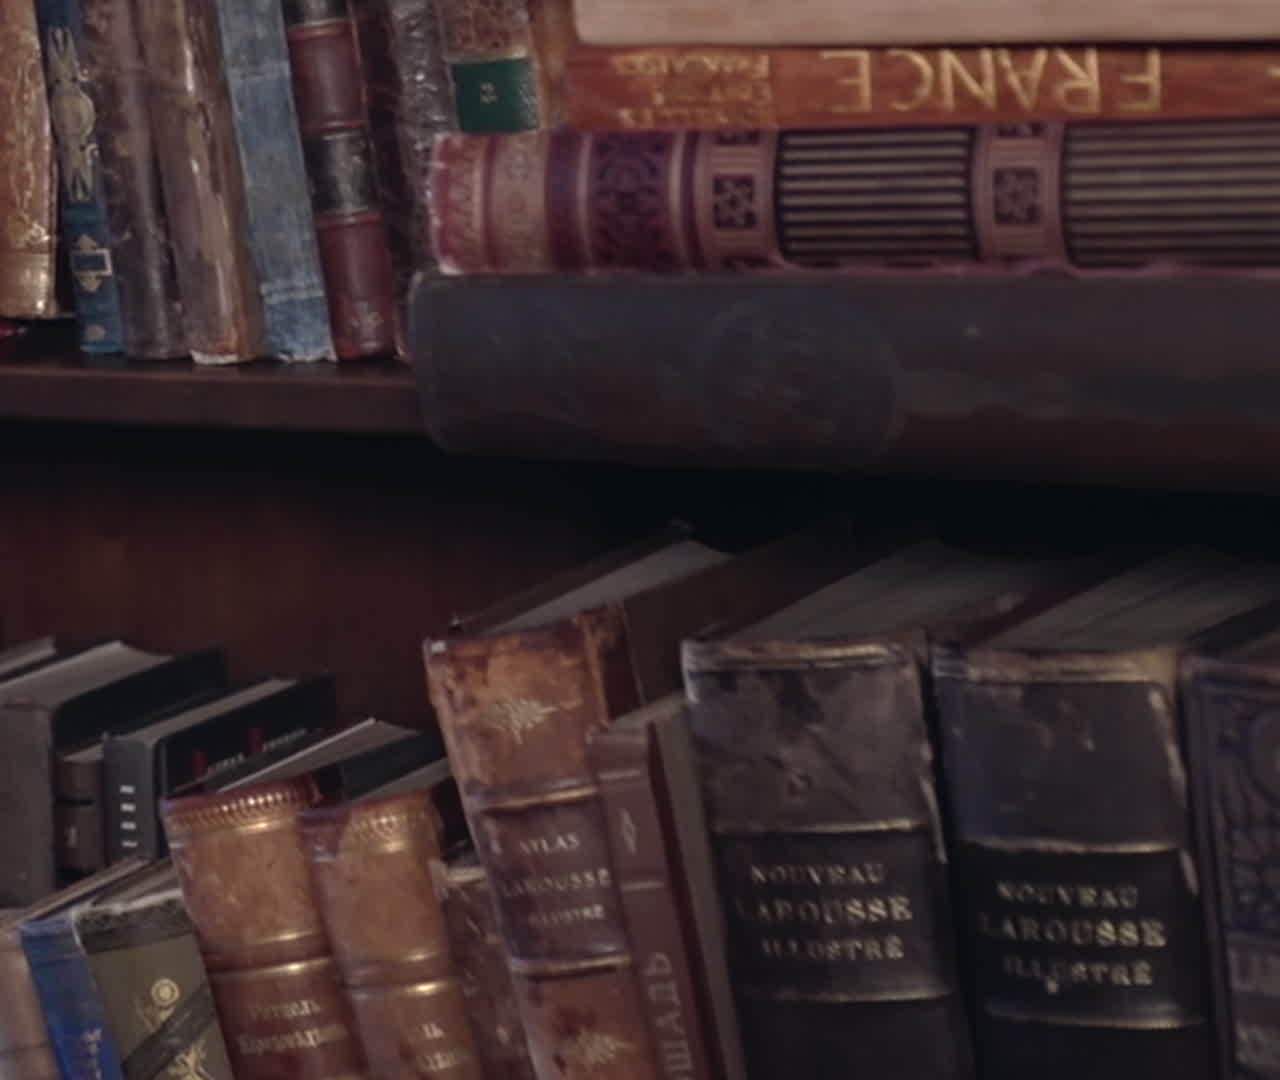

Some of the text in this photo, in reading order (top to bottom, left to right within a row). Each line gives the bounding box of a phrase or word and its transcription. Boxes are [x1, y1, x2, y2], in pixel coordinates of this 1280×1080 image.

[821, 48, 1163, 113] FRANCE
[749, 862, 887, 886] NOUVEAU
[995, 880, 1139, 910] NOUVEAU
[978, 912, 1168, 948] LAROUSSE
[640, 951, 697, 1080] ШАДЬ
